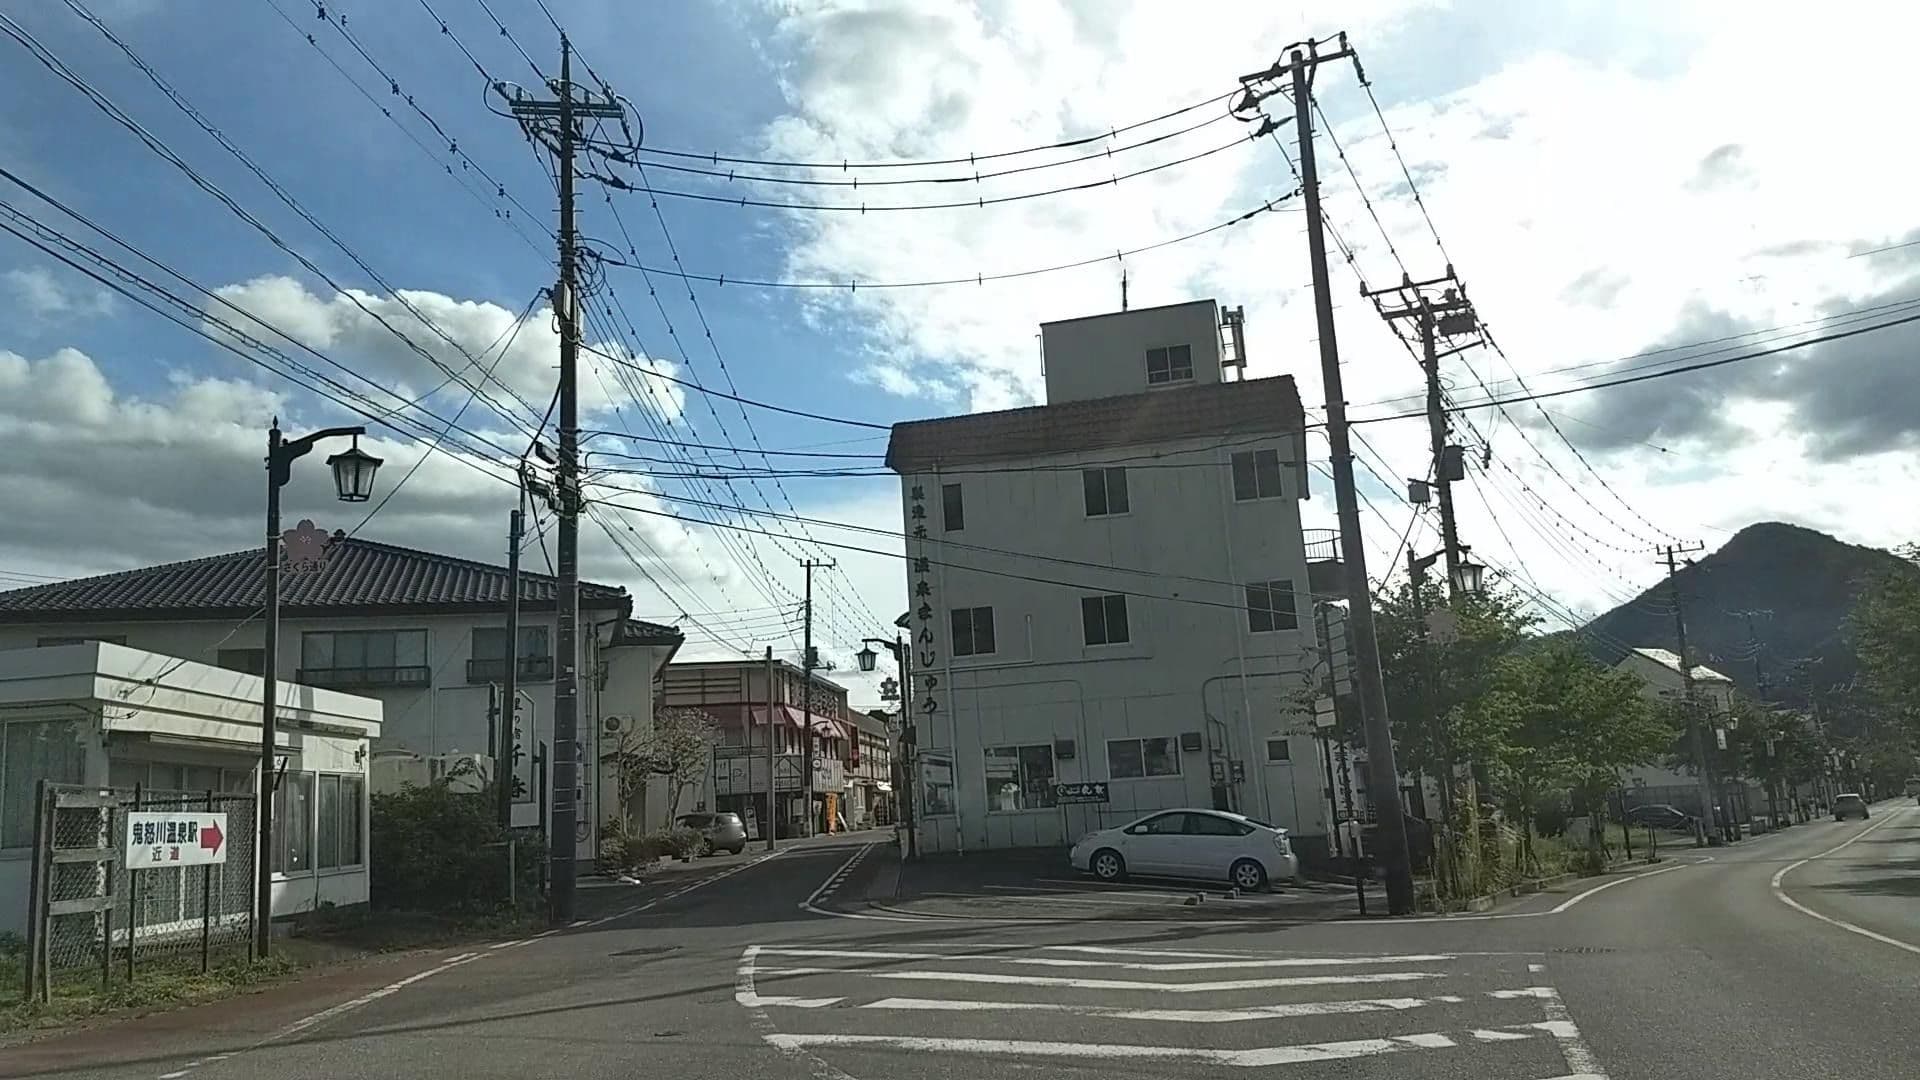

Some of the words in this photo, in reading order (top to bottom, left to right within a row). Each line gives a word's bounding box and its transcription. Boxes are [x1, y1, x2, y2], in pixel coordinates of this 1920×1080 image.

[131, 820, 199, 846] 鬼怒川温泉駅
[151, 846, 180, 862] 近道
